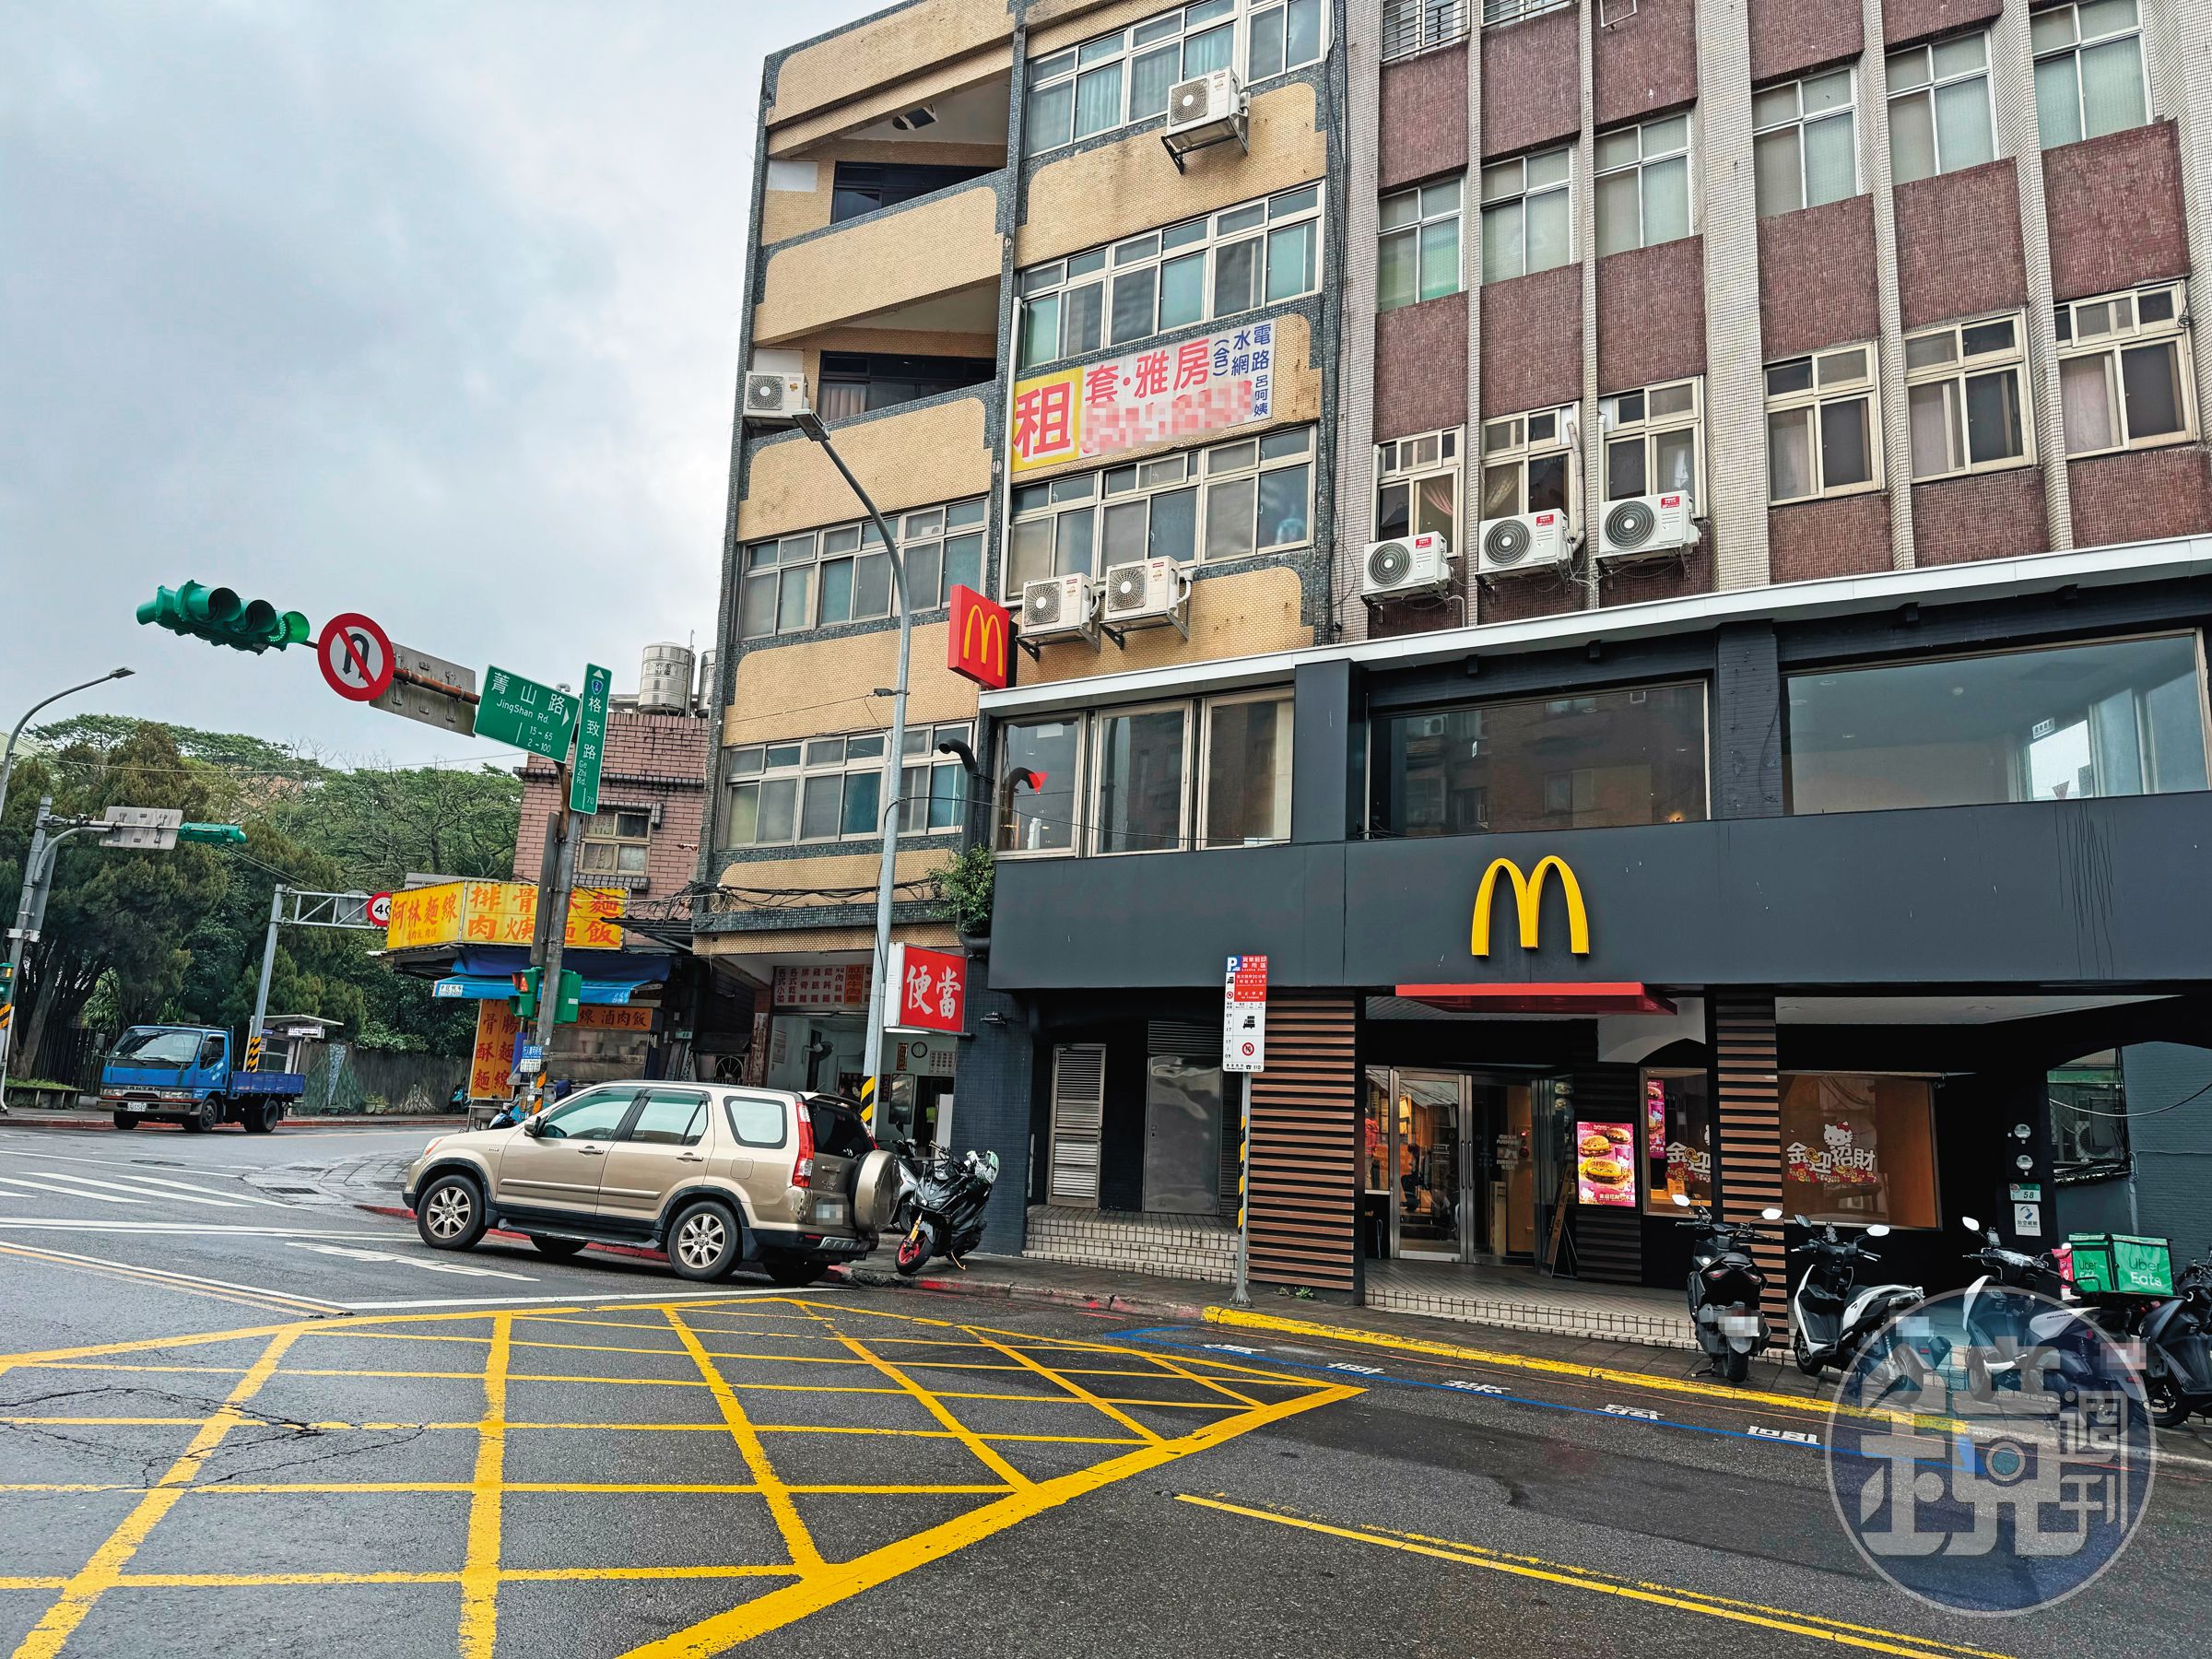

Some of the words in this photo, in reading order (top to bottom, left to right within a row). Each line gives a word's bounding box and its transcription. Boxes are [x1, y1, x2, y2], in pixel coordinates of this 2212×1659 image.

[1253, 374, 1269, 417] 呂阿姨
[1013, 382, 1071, 458] 租
[491, 672, 565, 716] 菁山路
[496, 699, 534, 719] JingShan
[536, 712, 550, 724] Rd.
[582, 696, 603, 761] 格致路
[577, 769, 587, 778] Zhi
[579, 760, 588, 769] Ge
[576, 777, 586, 785] Rd.
[586, 796, 594, 805] 70
[392, 892, 458, 930] 阿林麵線
[470, 886, 620, 918] 排骨麵
[906, 964, 961, 1019] 便當
[601, 1009, 647, 1027] 滷肉飯
[2079, 1260, 2098, 1271] Uber
[2129, 1258, 2160, 1272] Uber
[2130, 1271, 2162, 1287] Eats
